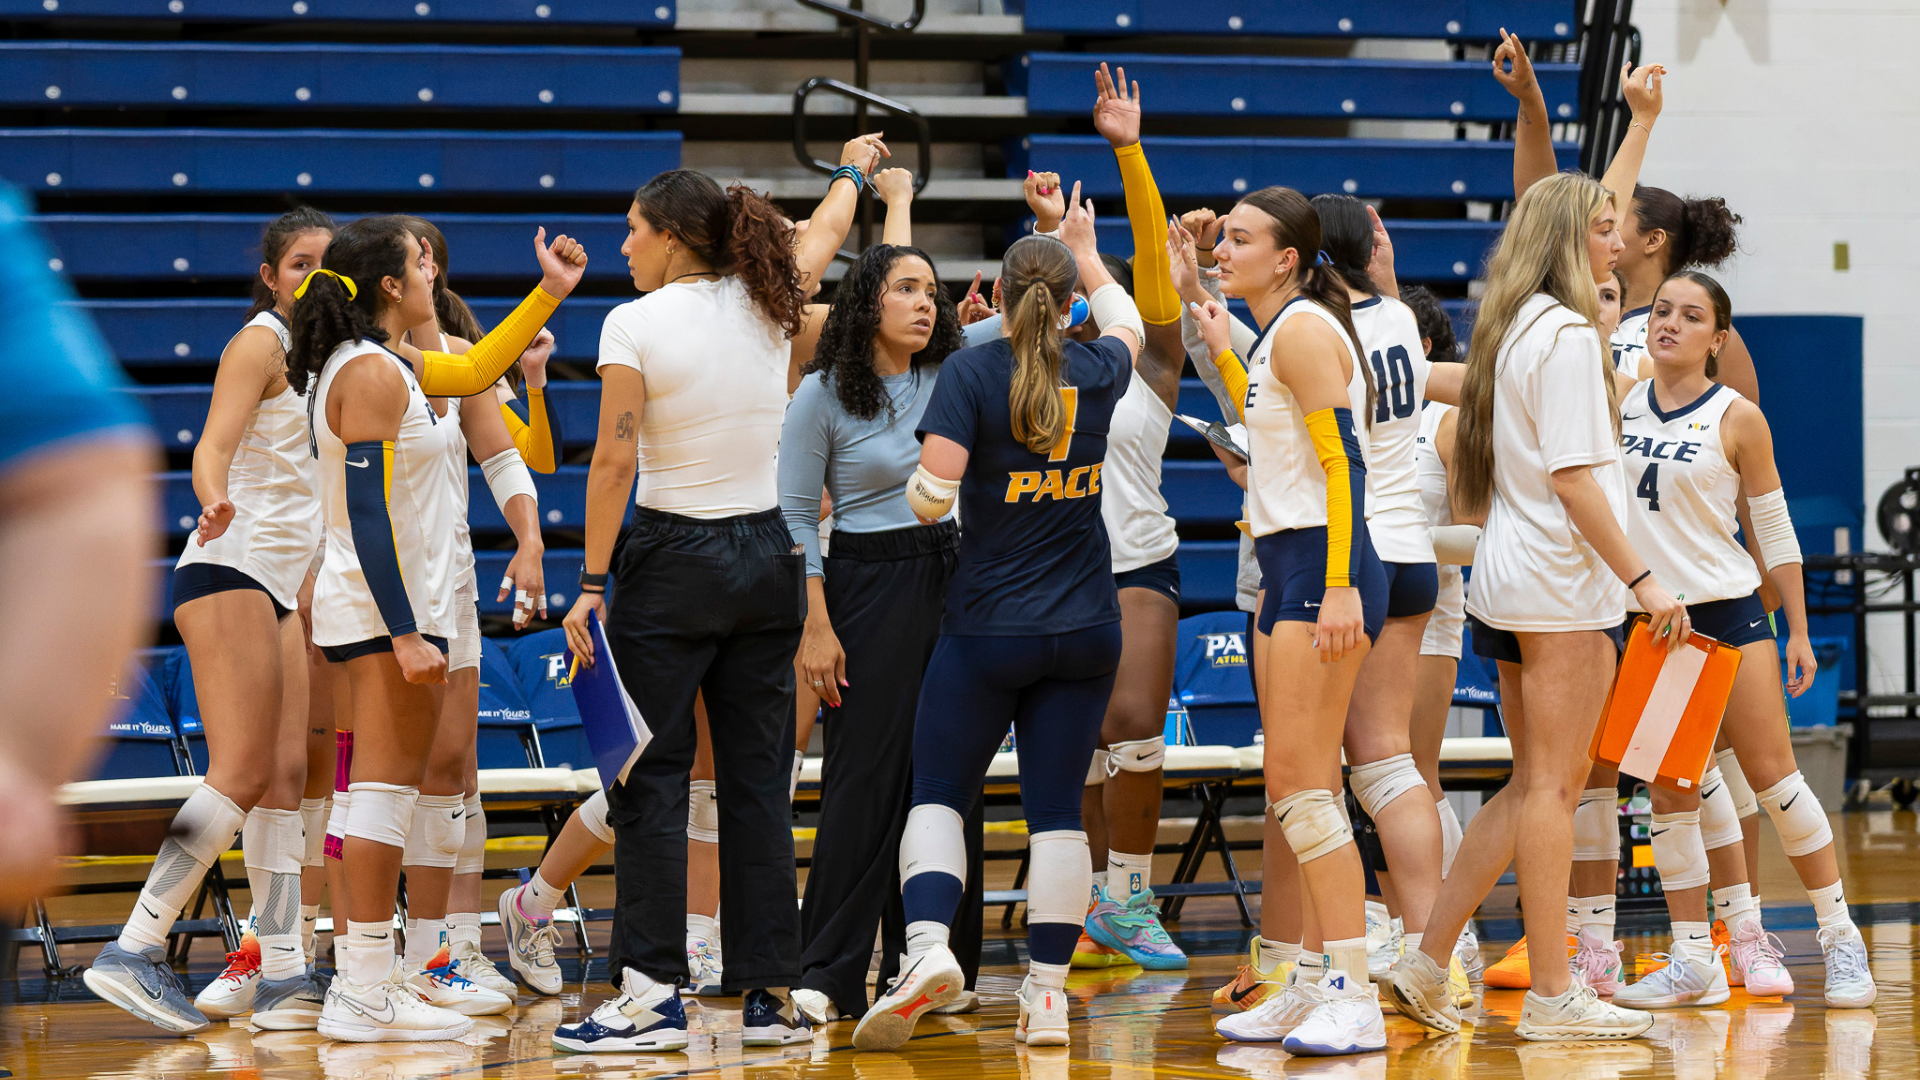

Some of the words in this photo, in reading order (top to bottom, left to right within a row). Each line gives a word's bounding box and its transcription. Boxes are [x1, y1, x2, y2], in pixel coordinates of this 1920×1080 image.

[1371, 344, 1416, 423] 10
[1416, 436, 1426, 444] 10
[1620, 434, 1702, 463] PACE
[1004, 461, 1104, 503] PACE
[1636, 462, 1661, 512] 4
[1206, 633, 1247, 657] PA
[1215, 655, 1248, 665] ATHL
[110, 723, 131, 731] MAKE
